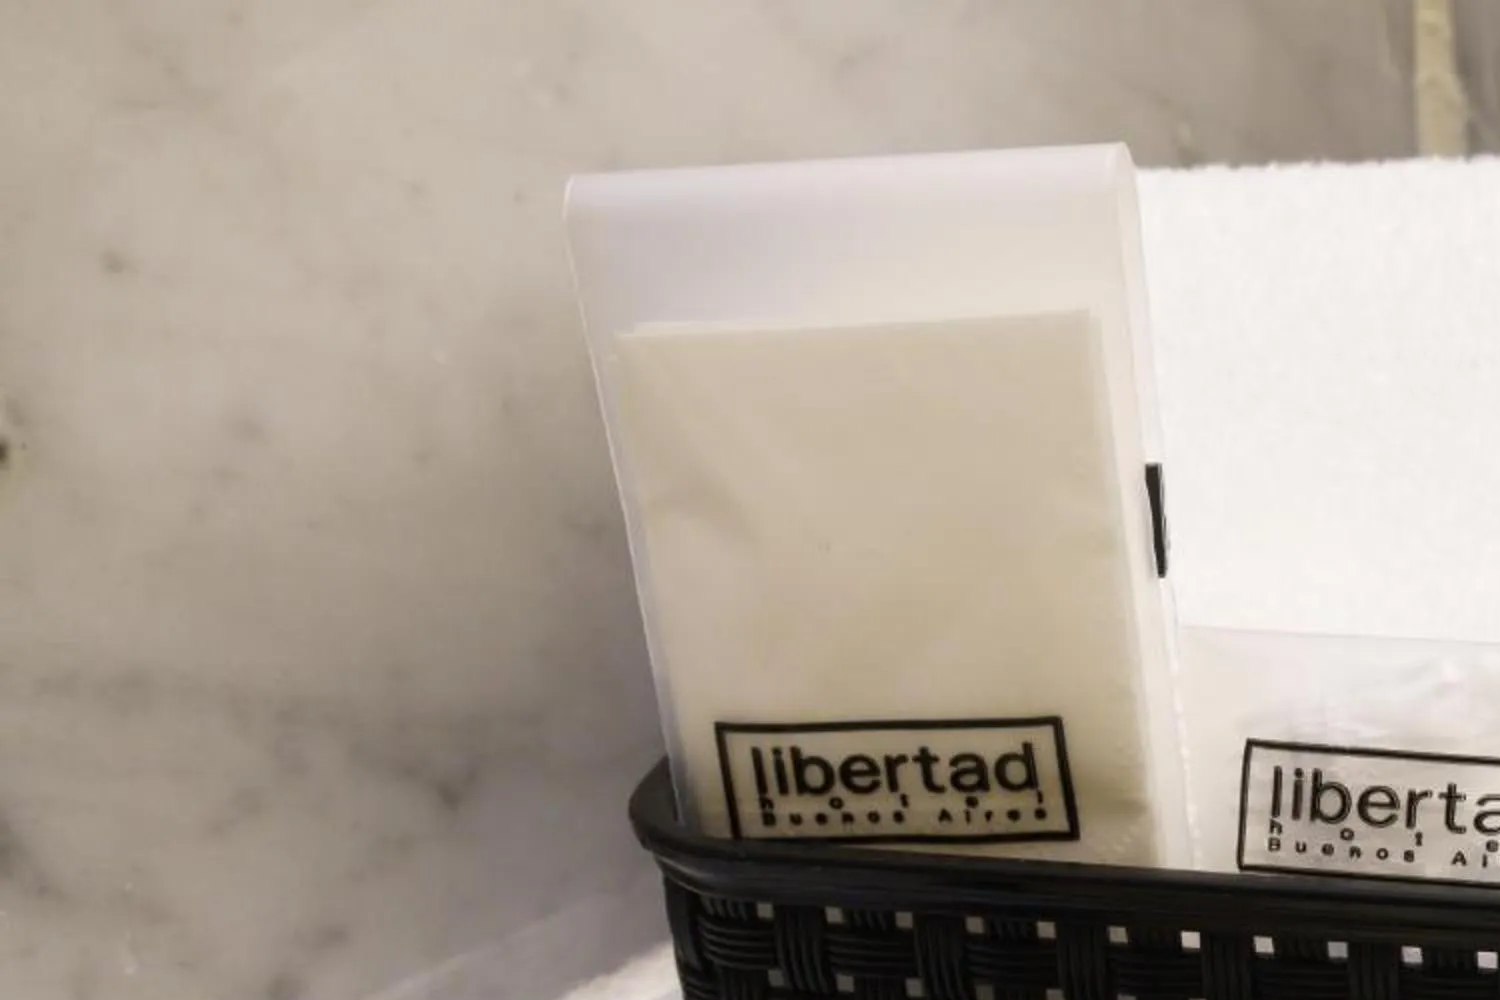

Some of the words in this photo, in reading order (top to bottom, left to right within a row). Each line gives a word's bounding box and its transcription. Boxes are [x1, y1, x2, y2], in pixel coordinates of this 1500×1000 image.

[751, 742, 1038, 797] libertad
[762, 809, 905, 827] Buenos
[938, 807, 1047, 824] Aires
[1267, 836, 1415, 863] Buenos
